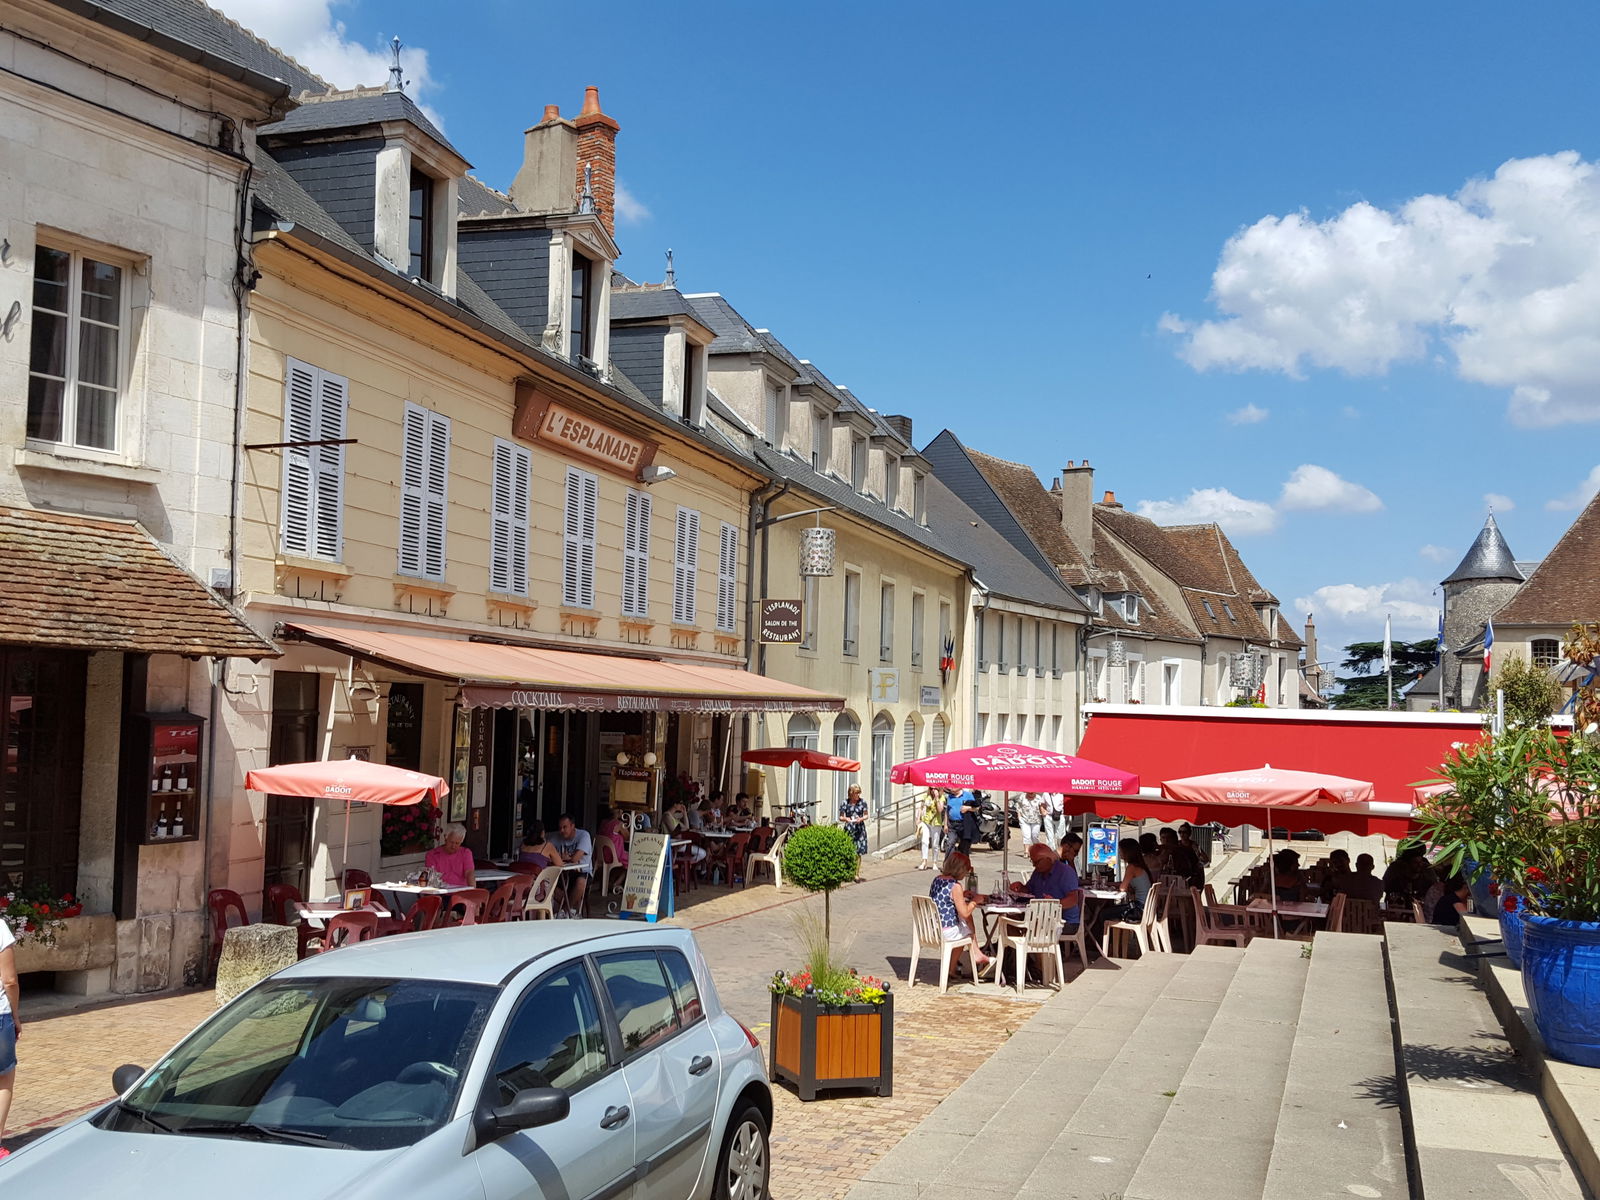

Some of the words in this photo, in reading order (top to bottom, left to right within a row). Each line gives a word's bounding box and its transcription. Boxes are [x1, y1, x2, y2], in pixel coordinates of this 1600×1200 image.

[546, 412, 639, 465] L'ESPLANADE
[763, 601, 800, 615] L'ESPLANADE
[762, 628, 801, 642] RESTAURANT
[511, 690, 562, 706] COCKTAILS
[617, 695, 660, 710] RESTAURANT
[478, 708, 486, 762] TAURANT
[970, 755, 1072, 766] BADOIT
[618, 768, 649, 777] l'Esplanade
[925, 772, 948, 780] BADOIT
[325, 785, 352, 794] BADOIT
[1097, 779, 1122, 787] ROUGE
